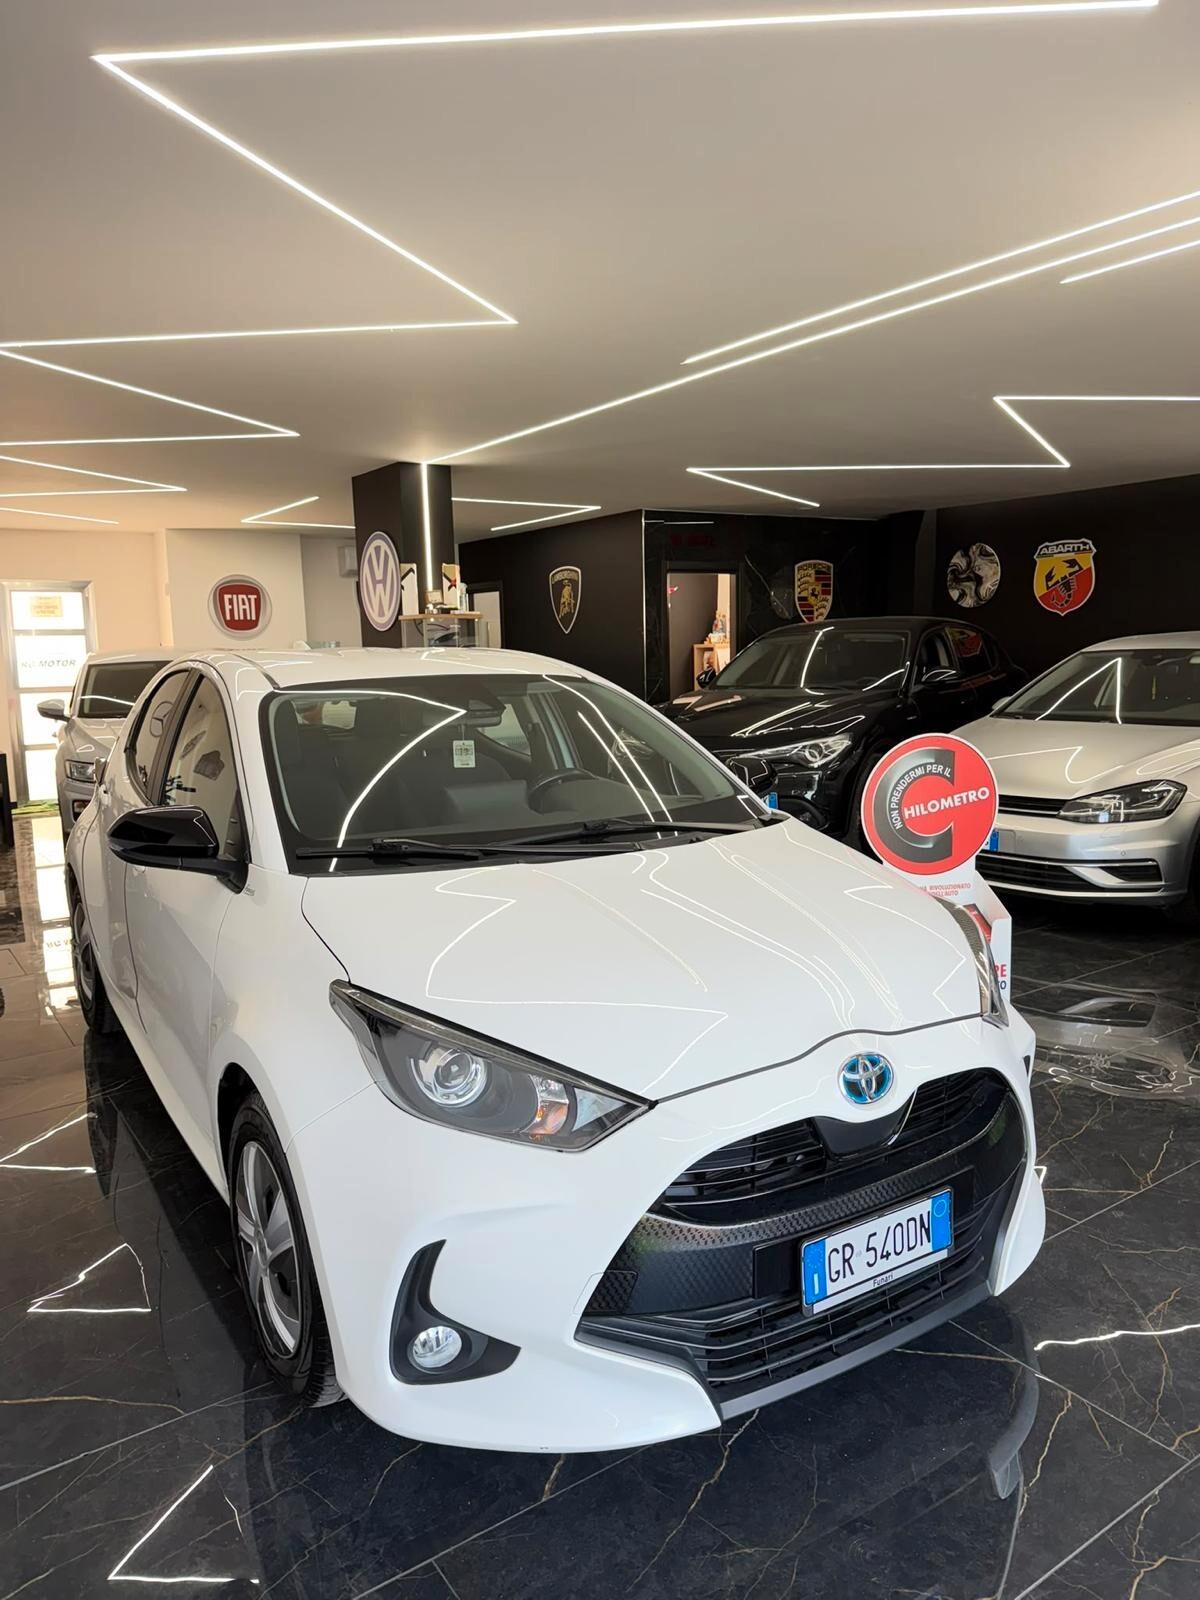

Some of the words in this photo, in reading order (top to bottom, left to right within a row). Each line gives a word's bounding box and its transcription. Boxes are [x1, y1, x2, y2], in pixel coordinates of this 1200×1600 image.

[1040, 544, 1090, 555] ABARTH
[223, 594, 258, 621] FIAT
[39, 659, 77, 667] MOTOR
[926, 764, 944, 775] PER
[944, 767, 952, 778] IL
[891, 766, 925, 809] PRENDERMI
[891, 810, 903, 830] NON
[828, 1242, 855, 1283] GR
[866, 1210, 931, 1268] 540DN
[872, 1273, 894, 1287] Funari
